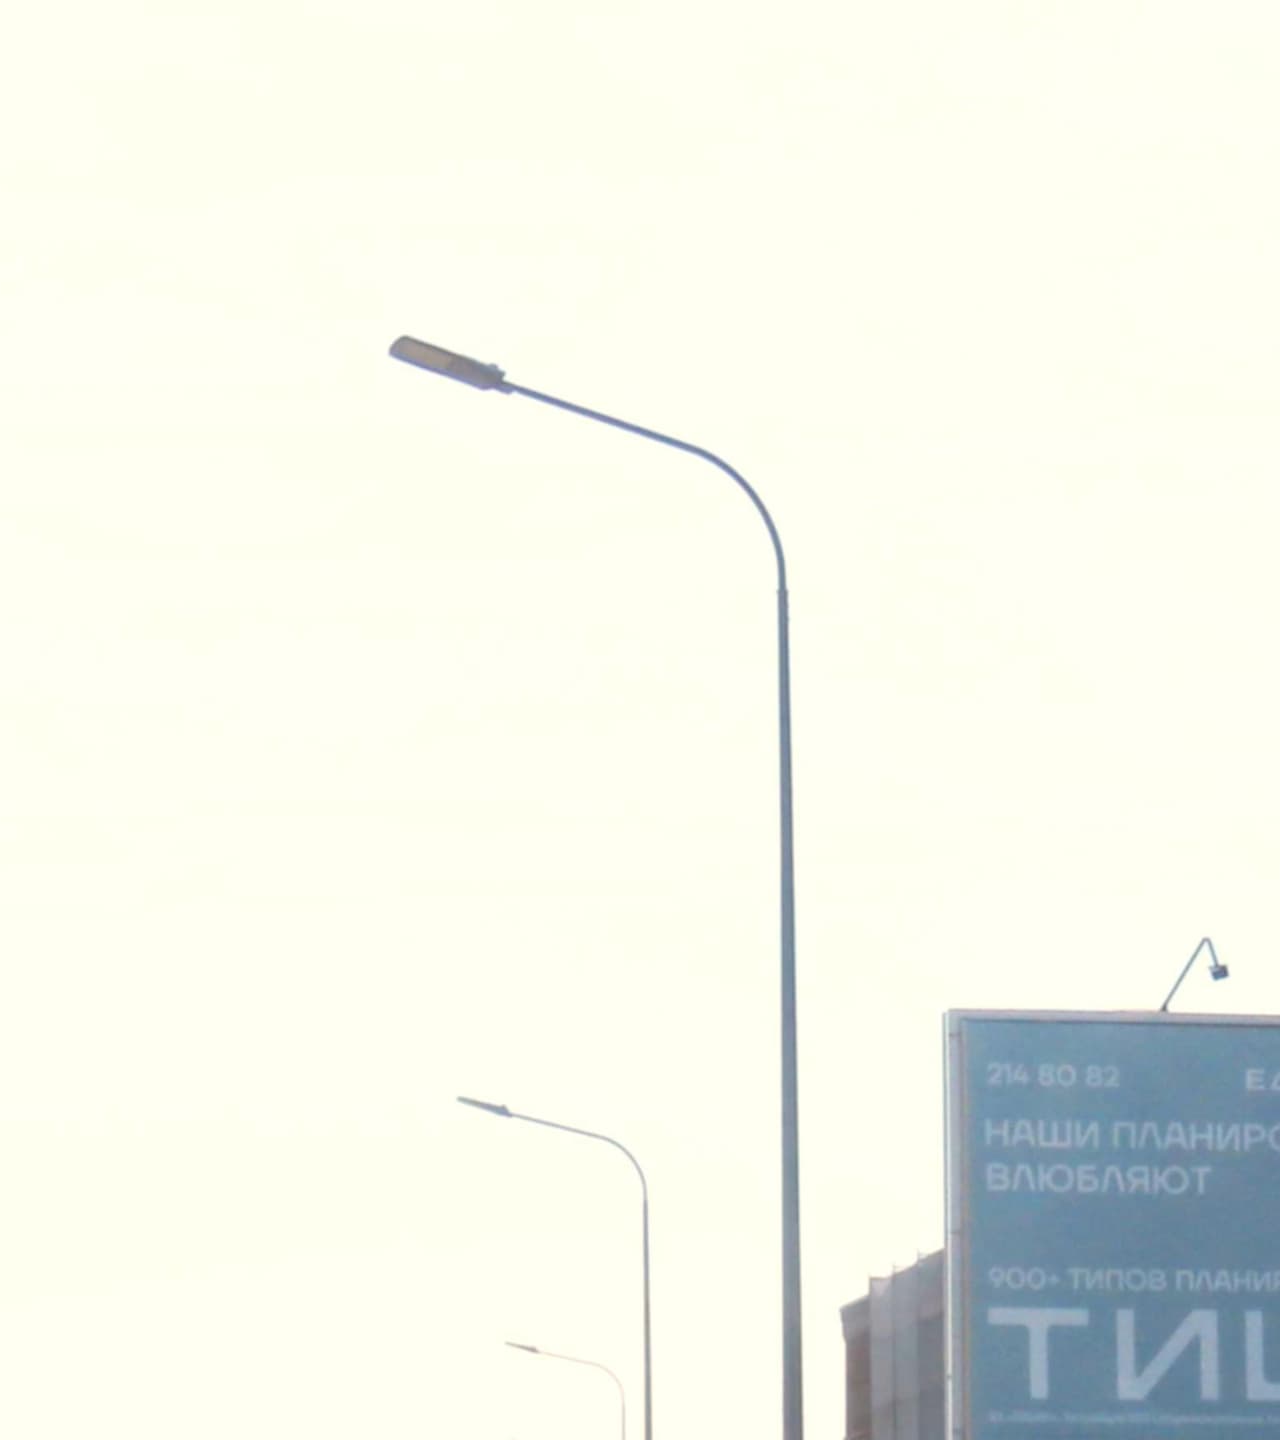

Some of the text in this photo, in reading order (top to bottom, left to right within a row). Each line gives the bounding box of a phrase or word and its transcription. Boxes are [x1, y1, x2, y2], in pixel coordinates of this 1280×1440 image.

[987, 1061, 1121, 1088] 214 80 82
[984, 1117, 1101, 1149] НАШИ
[985, 1162, 1212, 1196] ВЛЮБЛЯЮТ
[988, 1266, 1061, 1290] 900+
[1067, 1267, 1168, 1291] ТИПОВ
